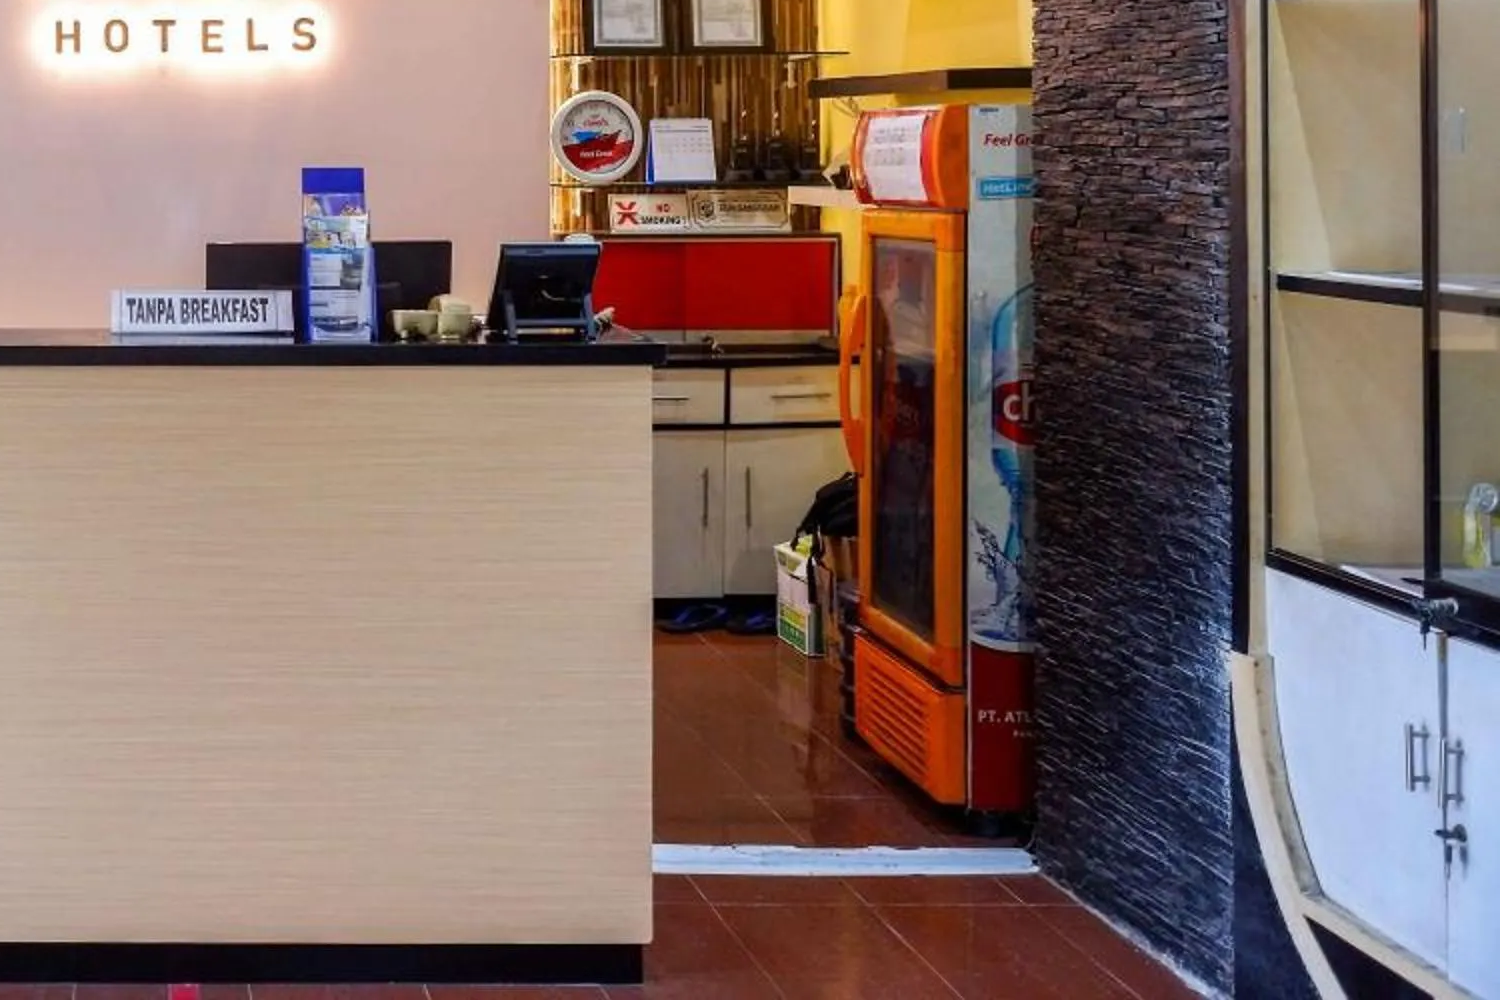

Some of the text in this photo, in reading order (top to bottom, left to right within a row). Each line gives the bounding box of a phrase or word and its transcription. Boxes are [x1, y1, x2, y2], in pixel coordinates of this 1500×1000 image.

[54, 17, 318, 54] HOTELS
[983, 133, 1013, 147] Feel
[655, 202, 672, 213] NO
[125, 297, 270, 325] TANPA BREAKFAST
[977, 709, 1034, 723] PT. ATL
